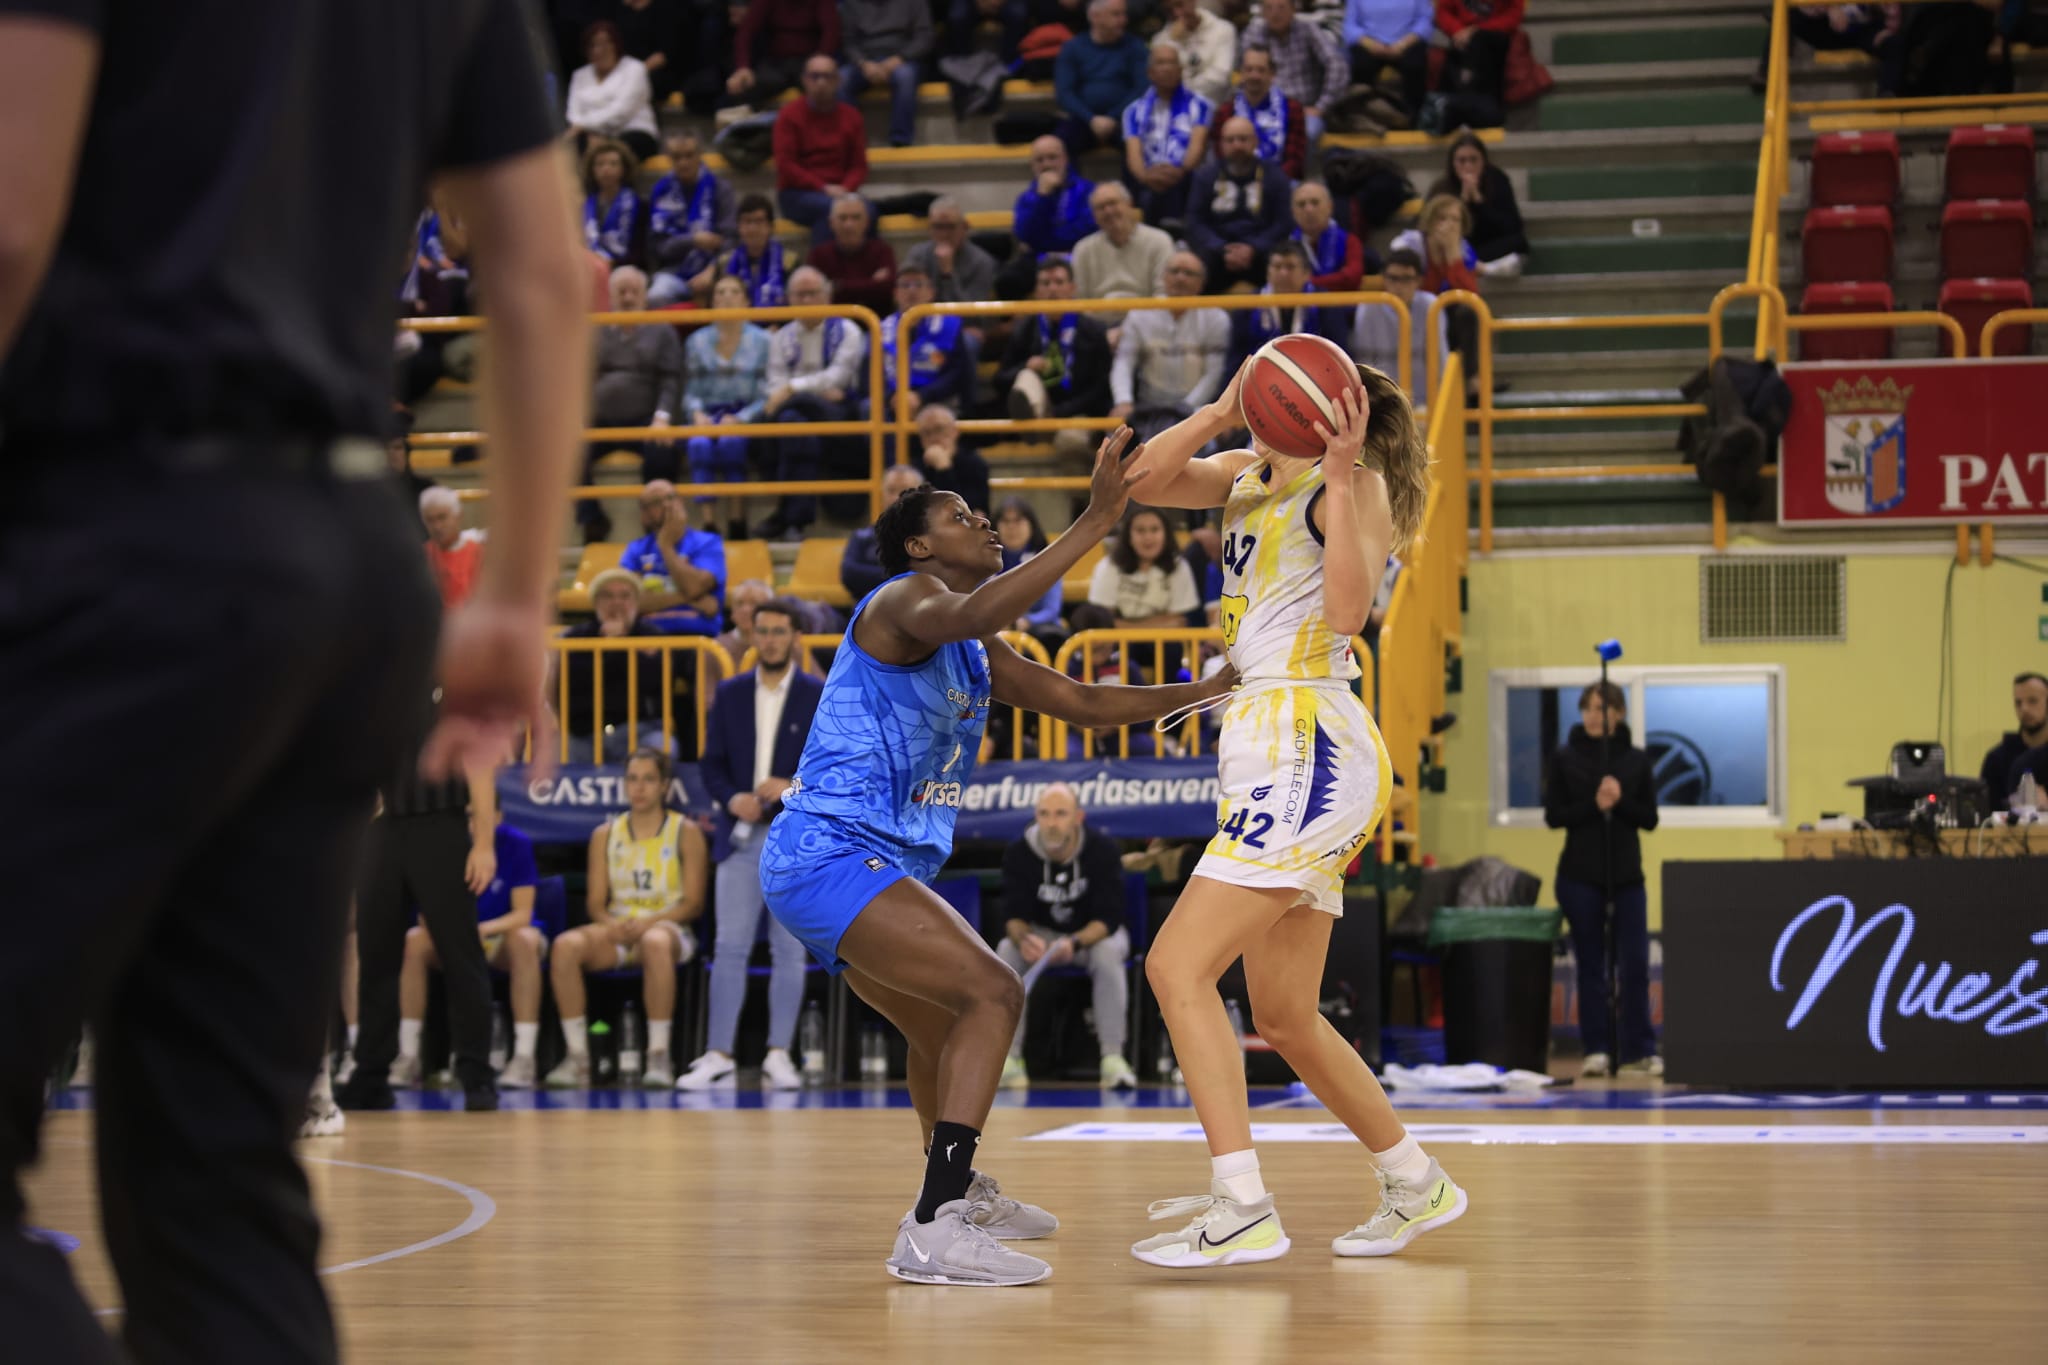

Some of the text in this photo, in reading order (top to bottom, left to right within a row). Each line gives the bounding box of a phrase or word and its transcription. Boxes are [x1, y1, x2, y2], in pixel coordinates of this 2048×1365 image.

[1268, 384, 1311, 430] molten
[1224, 532, 1256, 576] 42
[1282, 755, 1306, 824] TELECOM
[1223, 808, 1275, 849] 42
[632, 870, 653, 890] 12
[1769, 894, 2048, 1052] Nues
